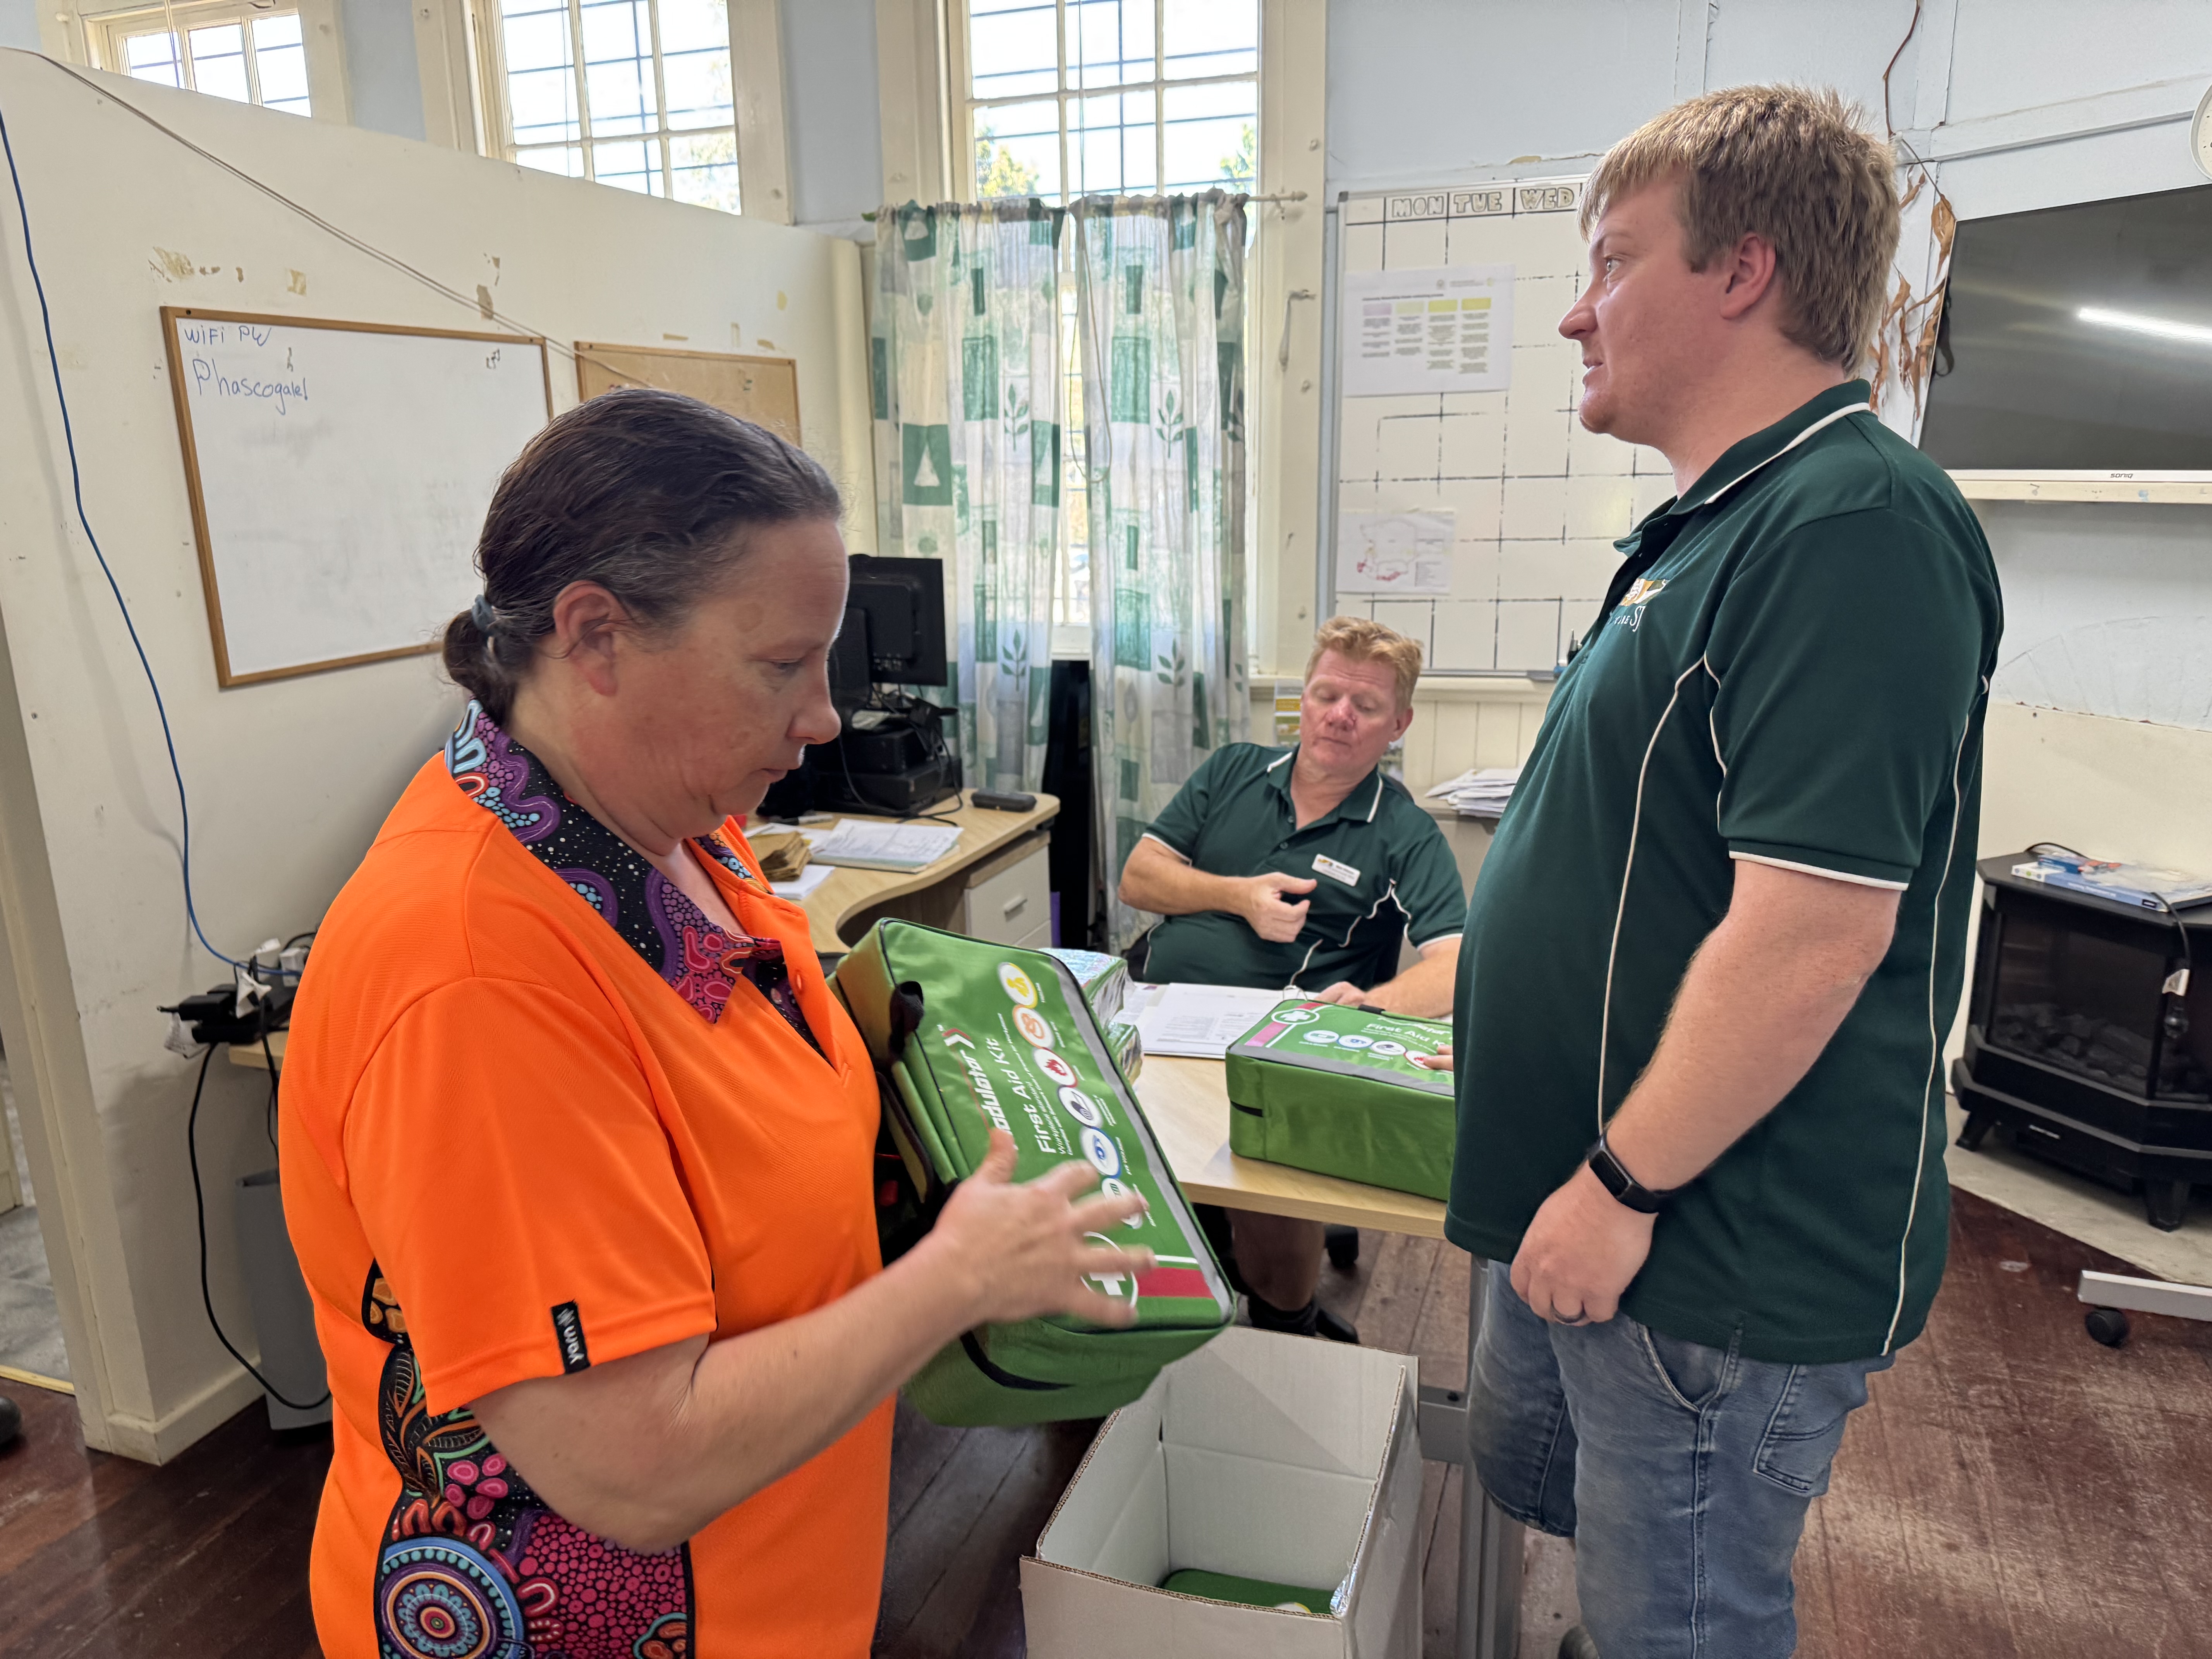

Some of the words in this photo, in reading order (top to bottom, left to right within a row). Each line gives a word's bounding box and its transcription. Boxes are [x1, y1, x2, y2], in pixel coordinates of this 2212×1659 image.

[1391, 195, 1444, 218] MON
[1454, 192, 1503, 213] TUE
[1520, 187, 1575, 210] WED
[238, 325, 271, 347] PW
[986, 1037, 1010, 1065] Kit
[1404, 1030, 1431, 1042] Aid
[1001, 1068, 1031, 1100] Aid
[960, 1049, 1019, 1151] odulator
[1024, 1104, 1057, 1154] First
